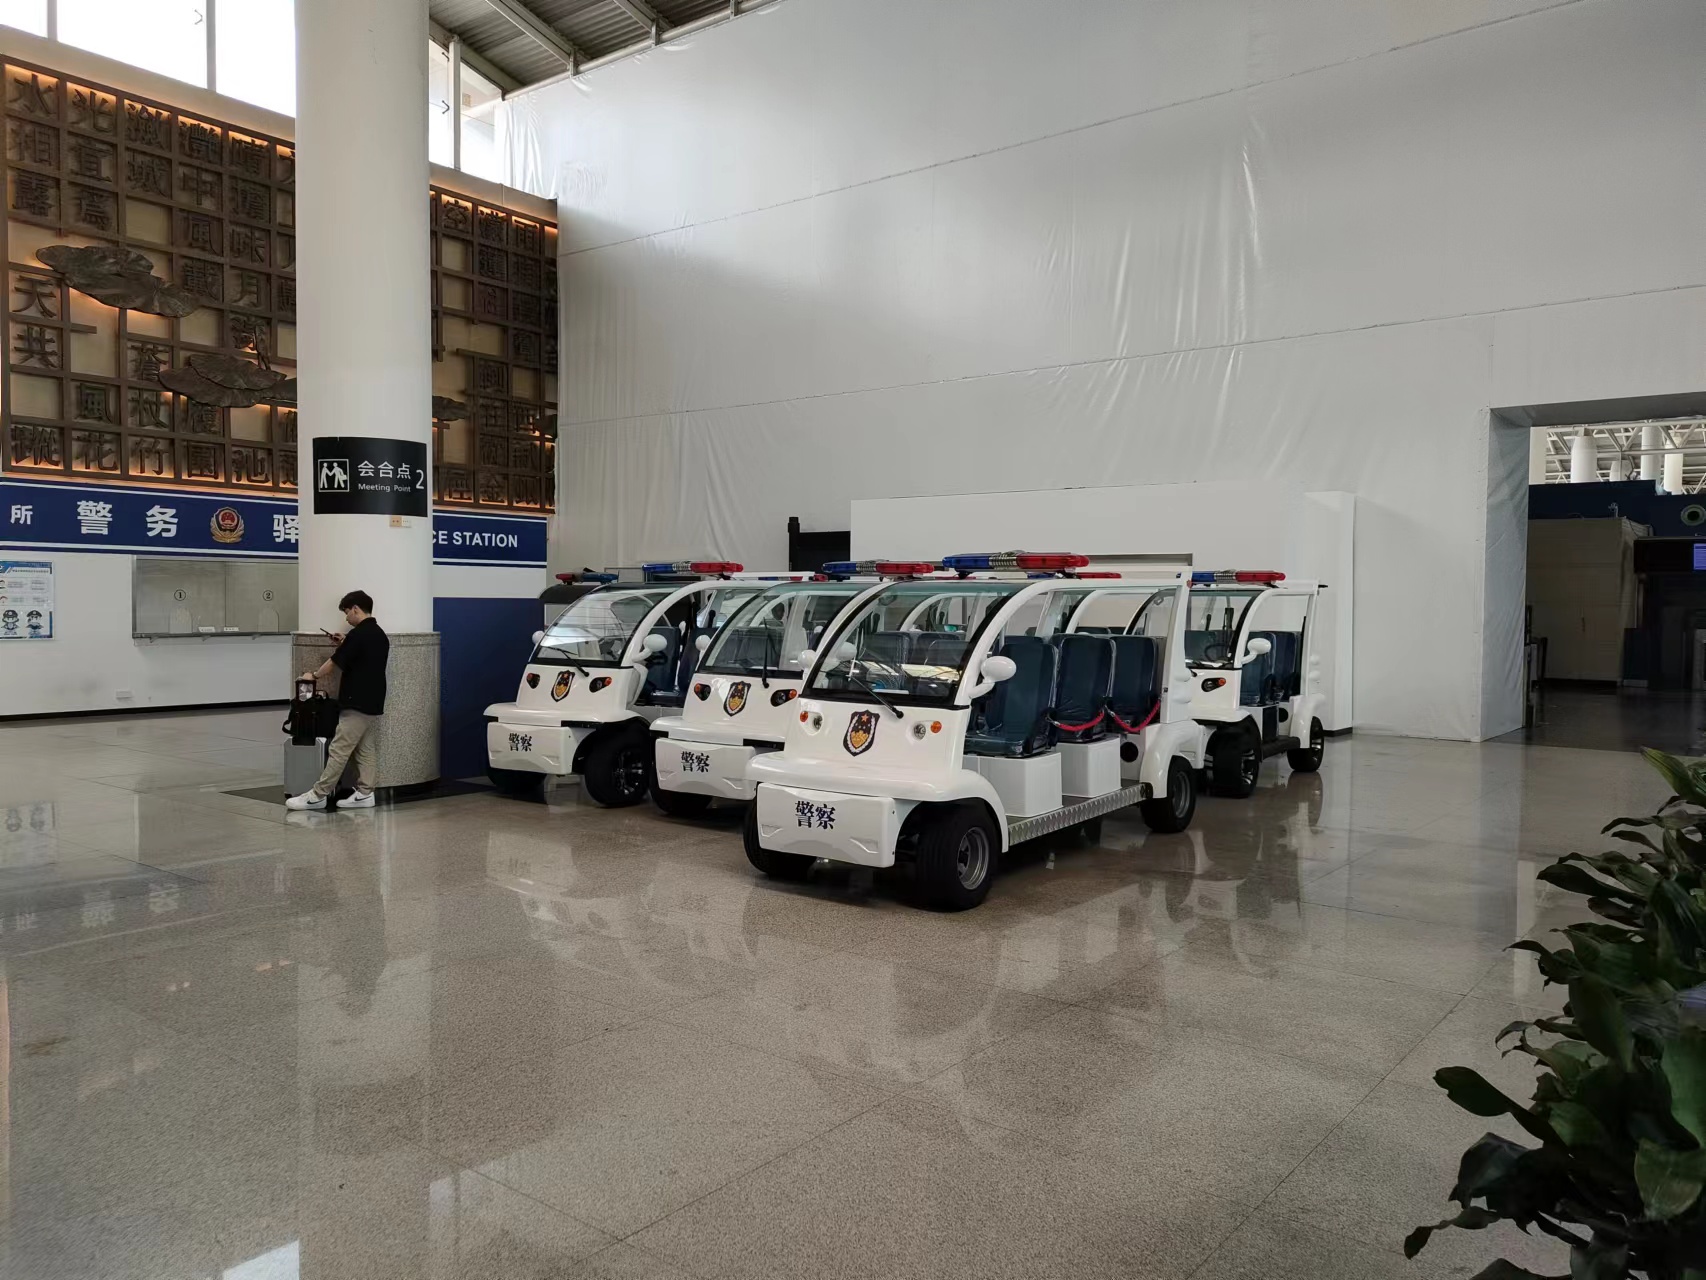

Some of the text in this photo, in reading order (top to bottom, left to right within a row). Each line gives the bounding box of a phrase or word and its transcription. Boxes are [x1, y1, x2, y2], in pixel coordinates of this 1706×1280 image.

[357, 460, 411, 480] 会合点
[415, 469, 425, 490] 2
[358, 483, 411, 493] Meeting Point
[10, 504, 33, 525] 所
[452, 531, 518, 548] STATION
[508, 732, 533, 752] 警察
[681, 751, 711, 773] 警察
[795, 801, 836, 830] 警察
